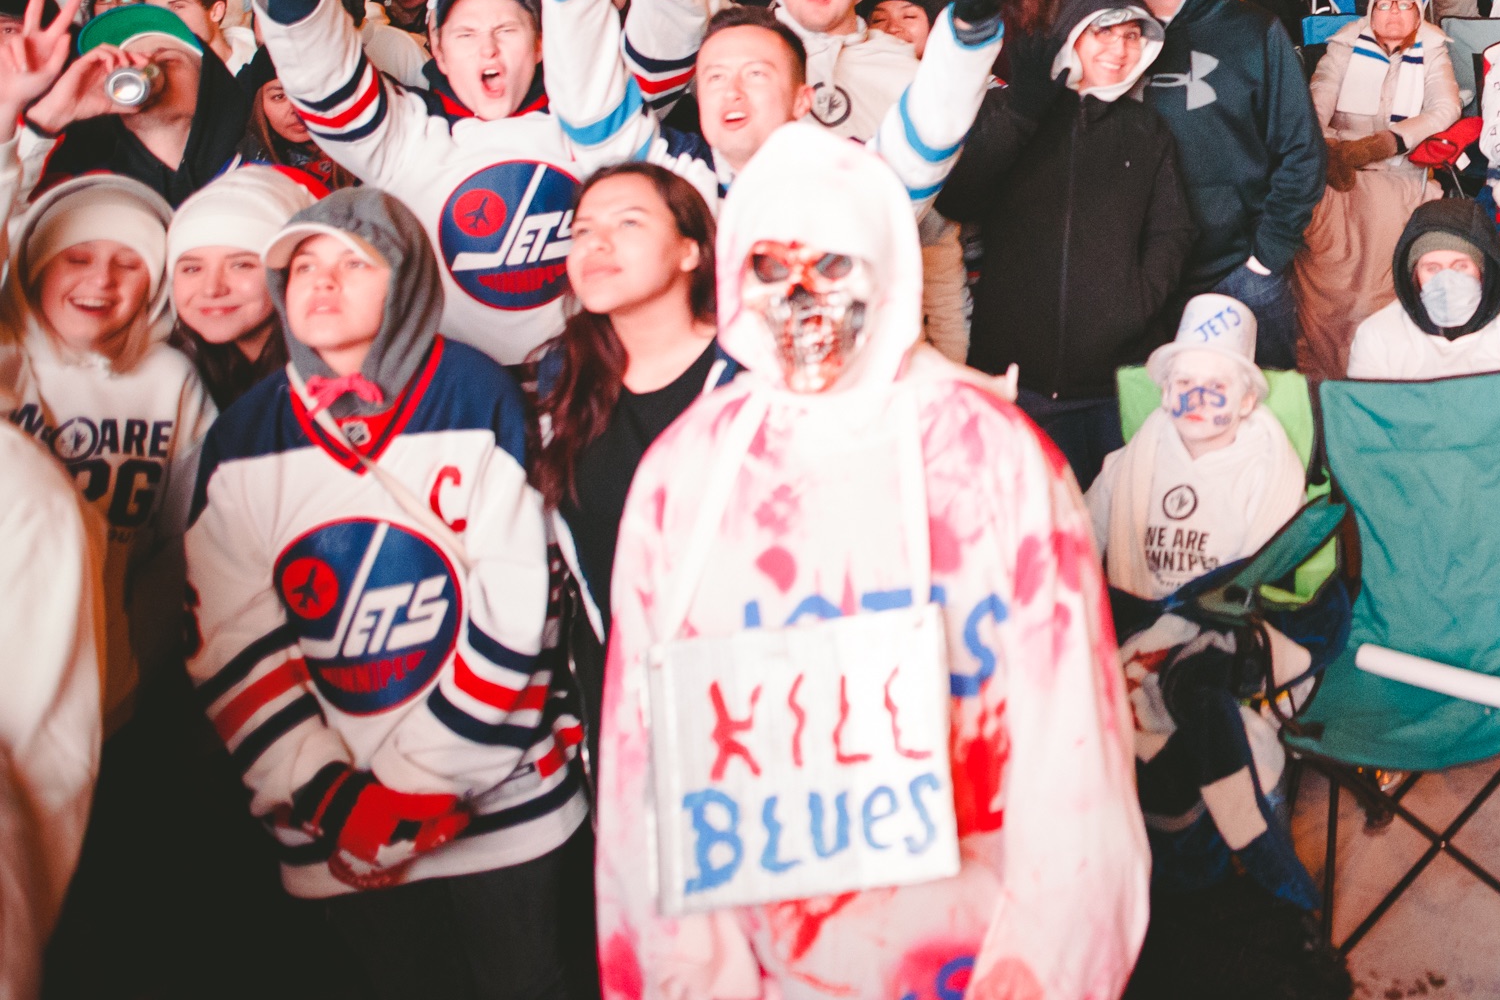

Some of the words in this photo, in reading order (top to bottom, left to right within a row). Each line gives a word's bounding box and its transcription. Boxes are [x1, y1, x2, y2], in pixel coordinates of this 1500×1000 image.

[1194, 306, 1241, 342] JETS
[95, 418, 173, 458] ARE
[429, 465, 467, 533] C
[1172, 528, 1209, 552] ARE
[299, 521, 449, 660] JETS
[709, 667, 932, 782] KILL
